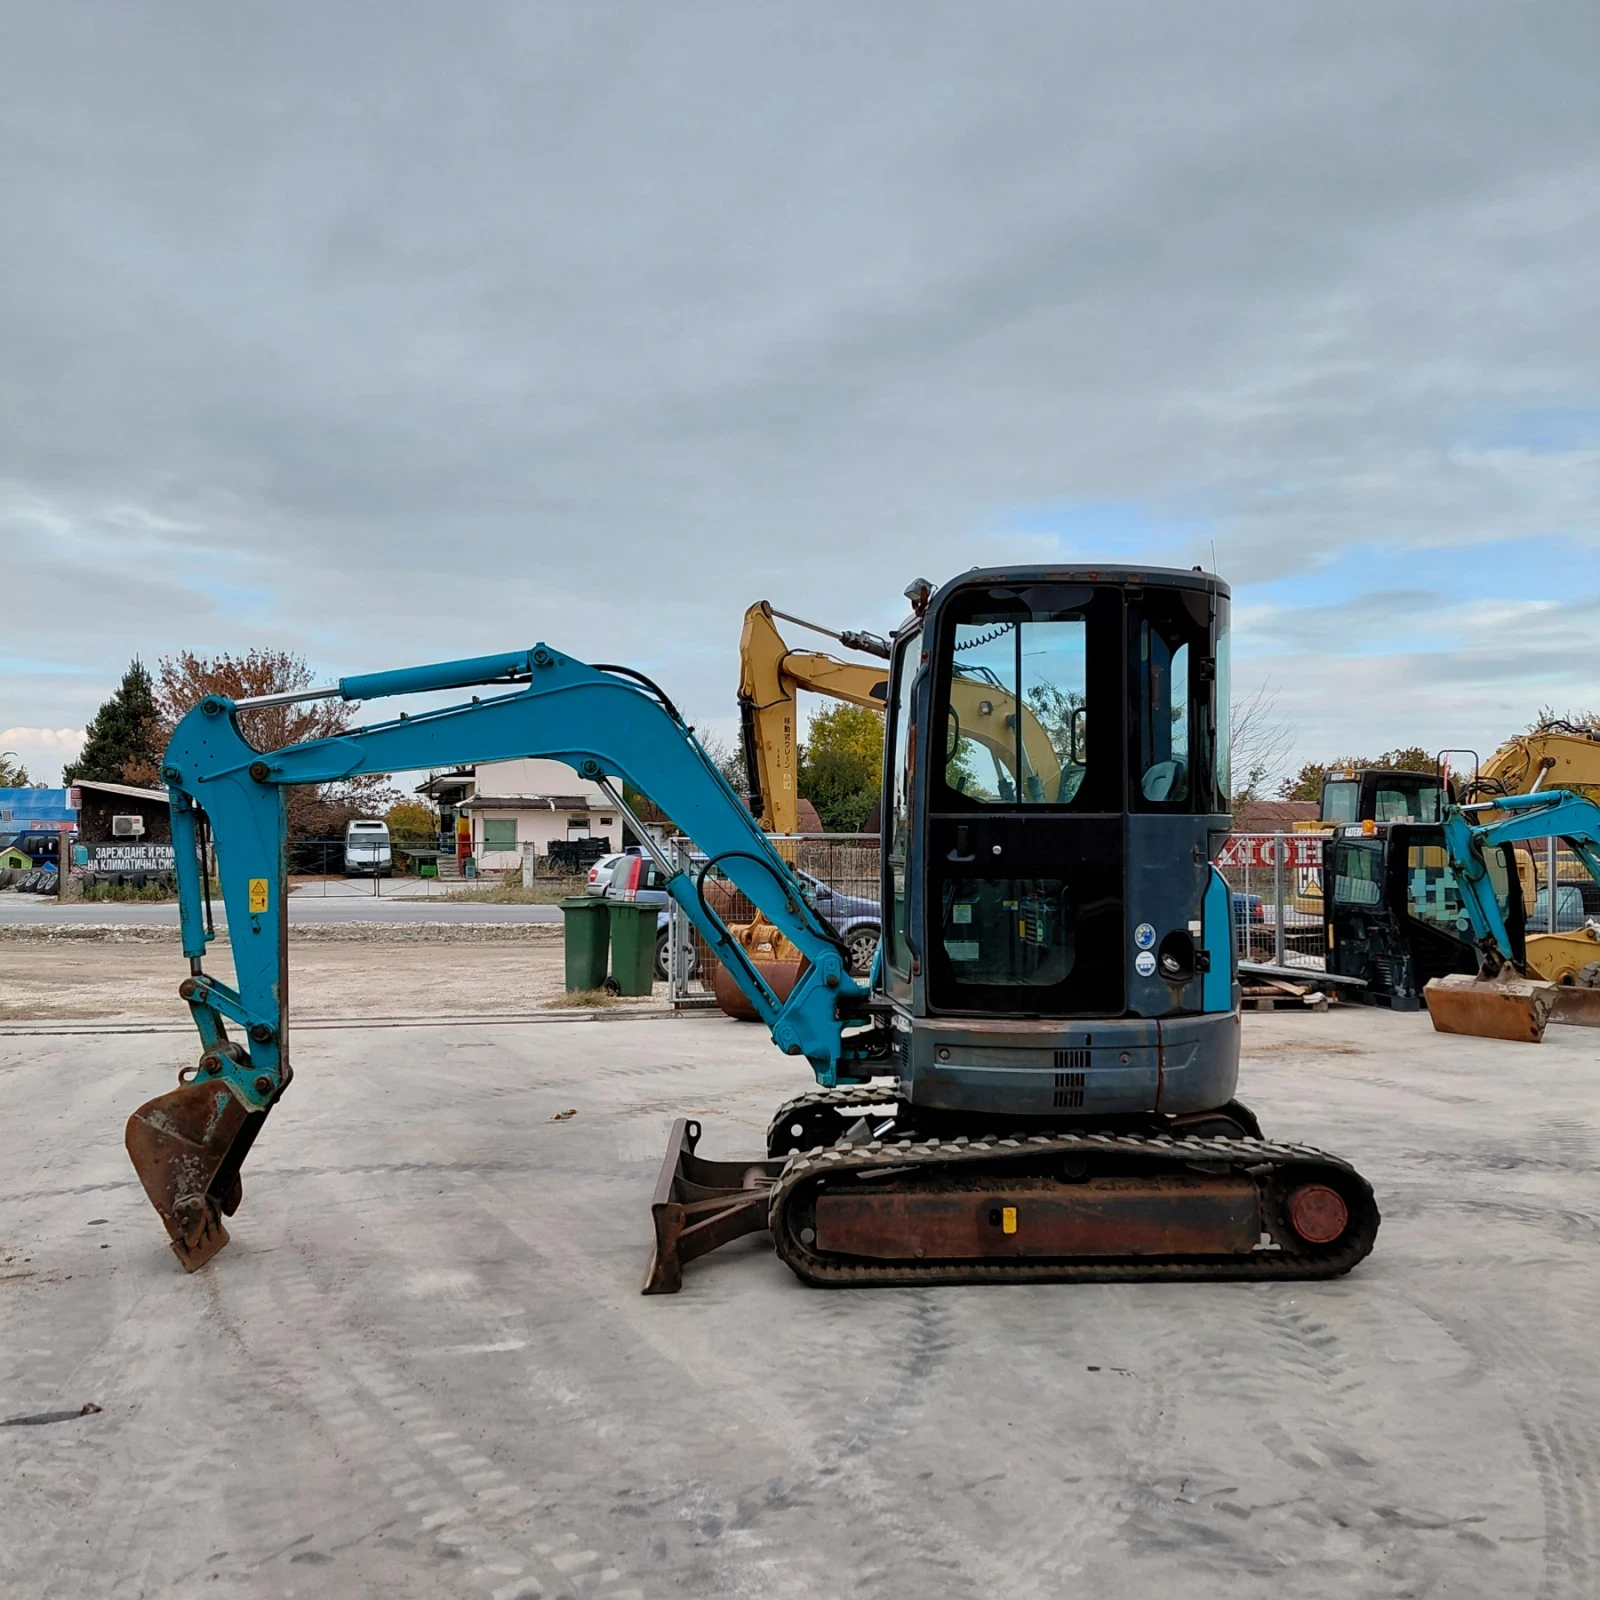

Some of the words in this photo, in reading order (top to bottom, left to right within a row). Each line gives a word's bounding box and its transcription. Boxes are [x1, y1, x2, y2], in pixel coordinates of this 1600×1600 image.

[95, 847, 147, 859] ЗАРЕЖДАНЕ
[156, 846, 175, 858] РЕМ
[87, 859, 99, 871] НА
[100, 858, 157, 871] КЛИМАТИЧНА
[158, 858, 175, 870] СИС
